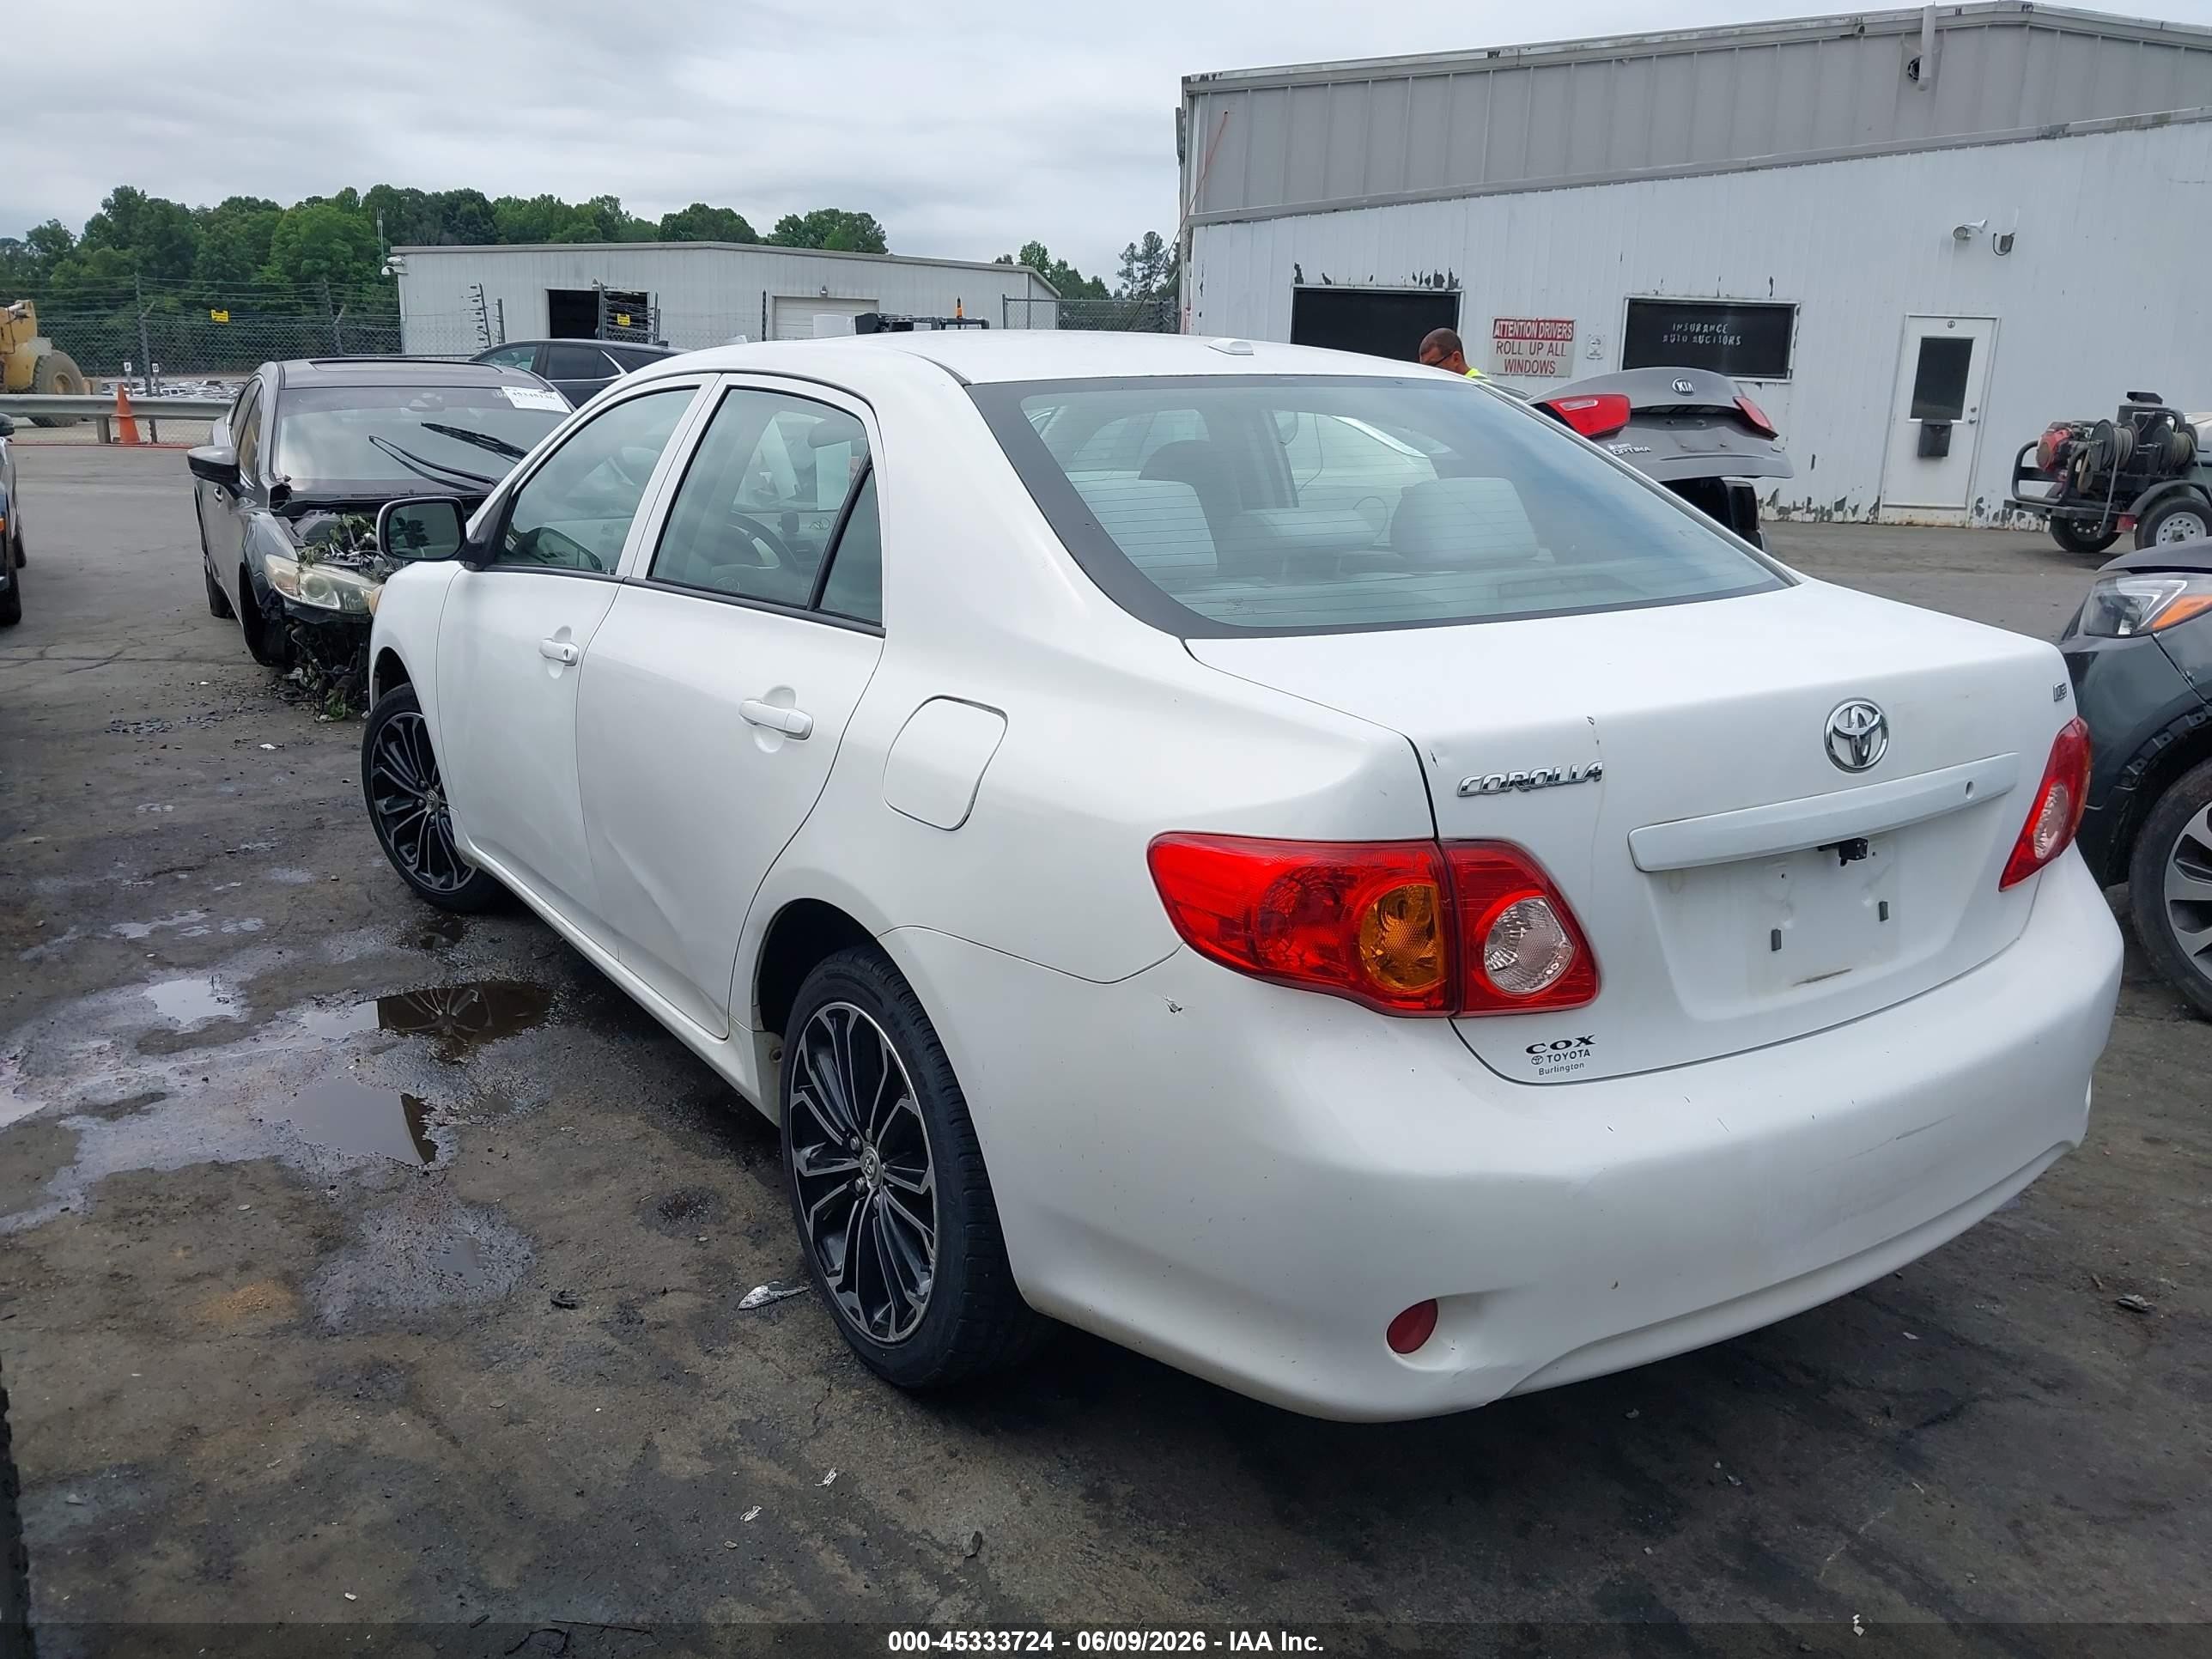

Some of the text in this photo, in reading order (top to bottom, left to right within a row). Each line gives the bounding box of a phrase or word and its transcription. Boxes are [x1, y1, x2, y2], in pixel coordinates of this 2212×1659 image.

[1493, 320, 1573, 339] ATTENTION DRIVERS
[1673, 322, 1729, 334] INSURANCE
[1662, 333, 1688, 344] AUTO
[1496, 340, 1567, 357] ROLL UP ALL
[1504, 358, 1556, 374] WINDOWS
[1612, 447, 1651, 456] OPTIMA
[1457, 761, 1603, 797] COROLLA
[1525, 1034, 1596, 1054] COX
[1547, 1048, 1591, 1063] TOYOTA
[1538, 1062, 1585, 1076] Burlington
